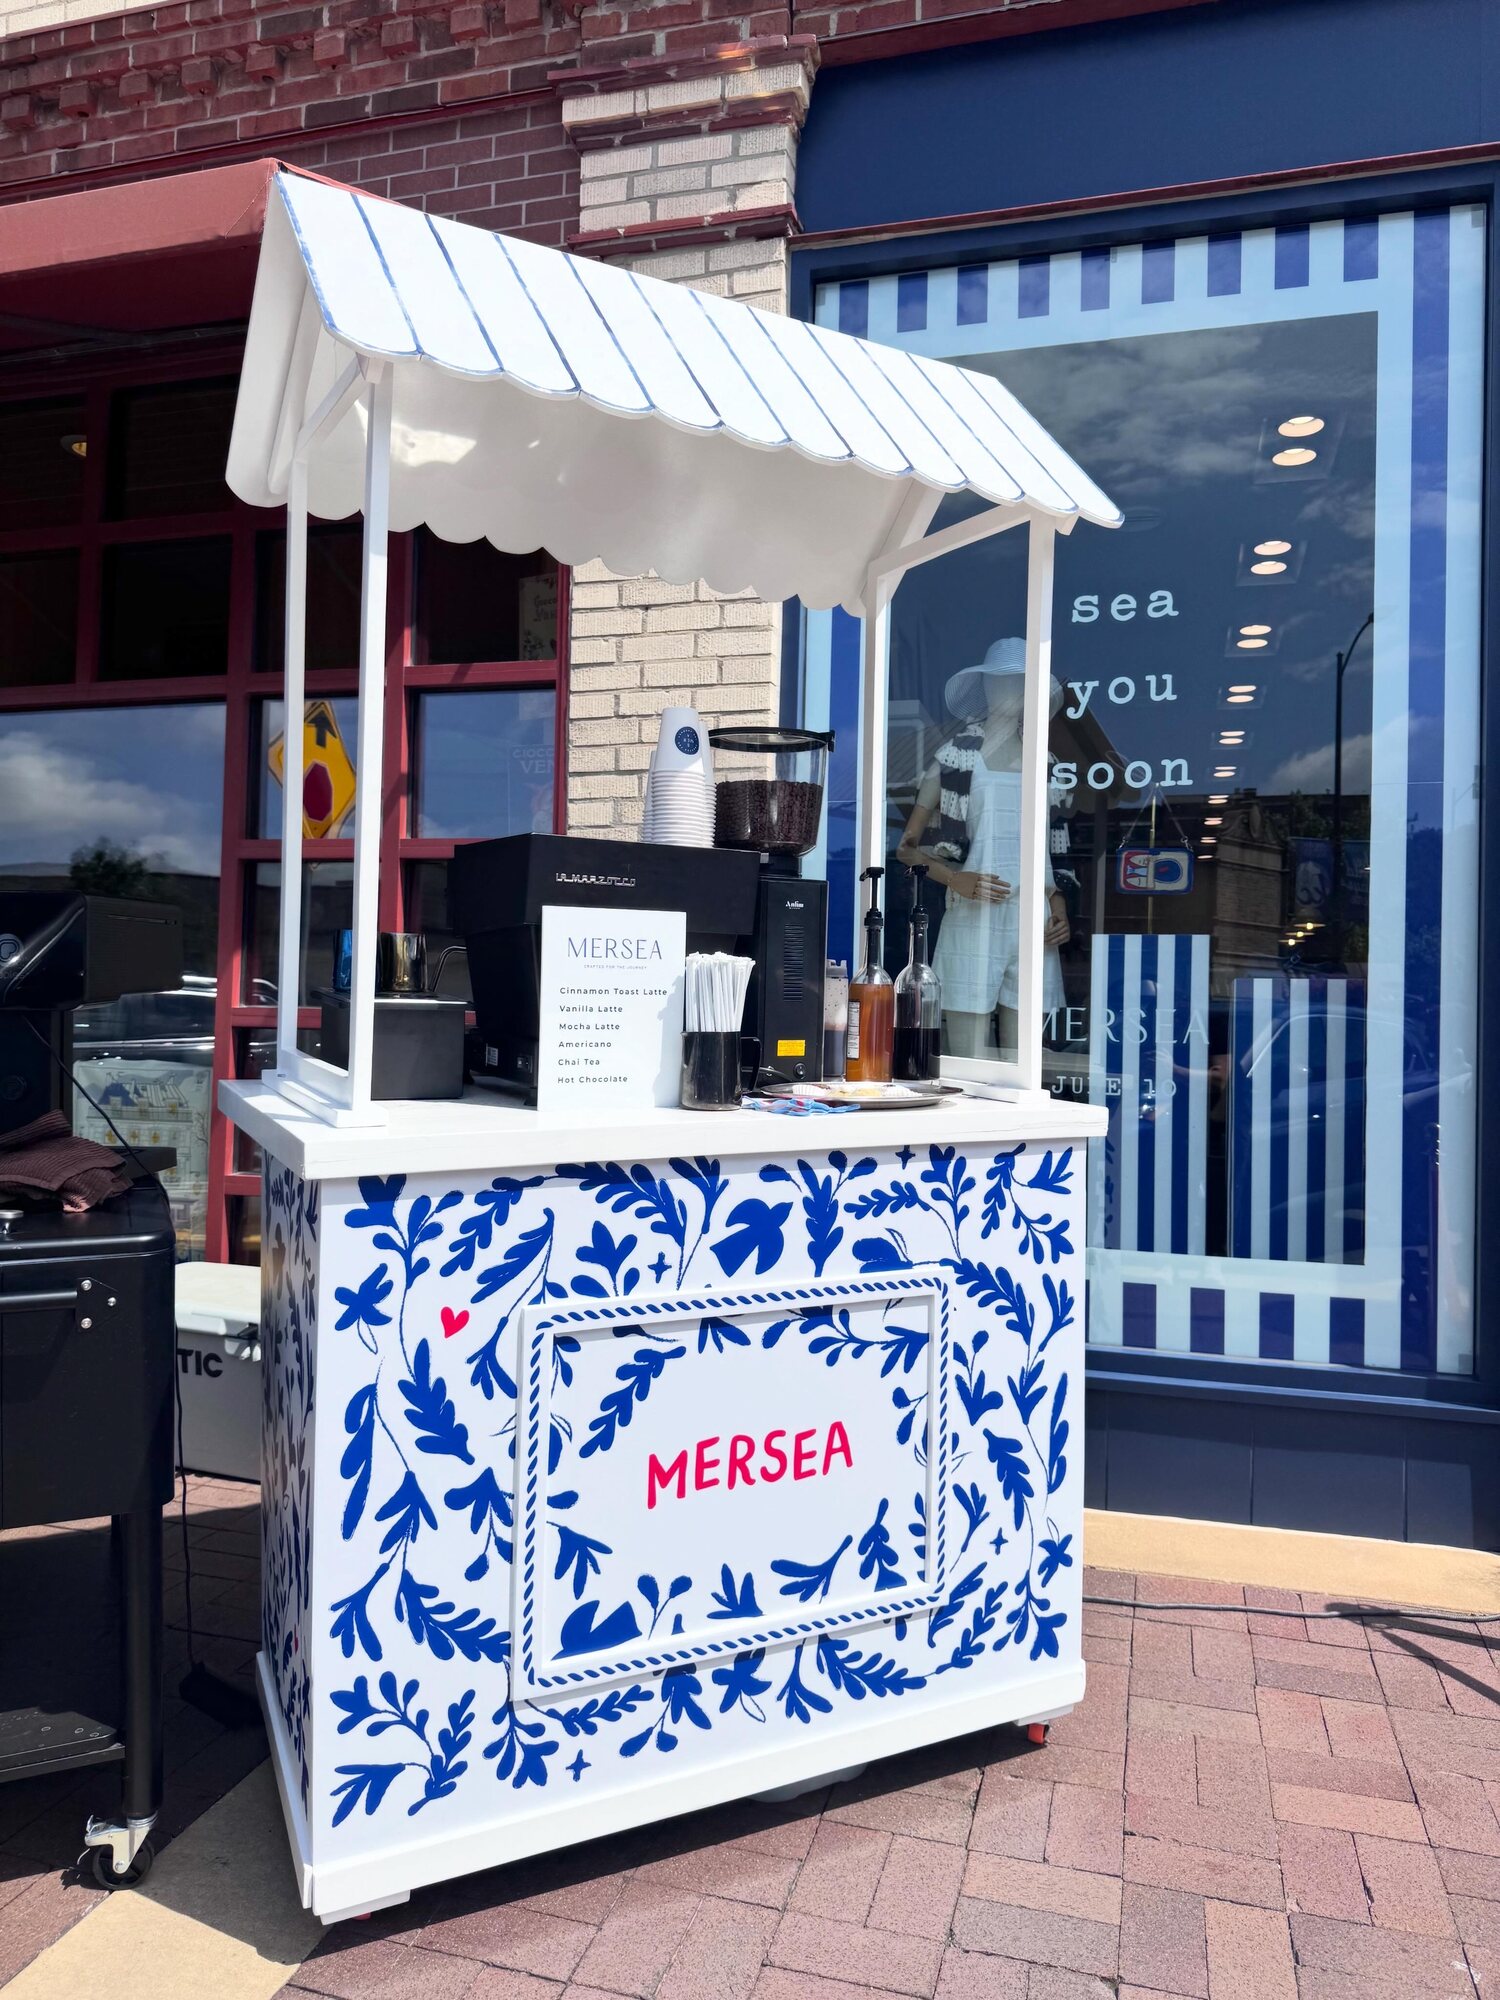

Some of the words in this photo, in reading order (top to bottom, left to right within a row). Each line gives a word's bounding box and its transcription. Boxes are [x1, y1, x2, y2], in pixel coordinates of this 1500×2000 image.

[1071, 590, 1180, 623] sea
[1066, 673, 1177, 719] you
[1049, 758, 1193, 790] soon
[567, 937, 662, 960] MERSEA
[559, 986, 610, 996] Cinnamon
[614, 988, 639, 996] Toast
[643, 988, 668, 996] Latte
[559, 1005, 594, 1013] Vanilla
[597, 1005, 623, 1013] Latte
[559, 1022, 591, 1031] Mocha
[595, 1023, 621, 1031] Latte
[558, 1040, 612, 1048] Americano
[558, 1058, 580, 1066] Chai
[557, 1076, 575, 1084] Hot
[578, 1075, 628, 1083] Chocolate
[1052, 1075, 1121, 1096] JUE
[647, 1421, 853, 1510] MERSEA
